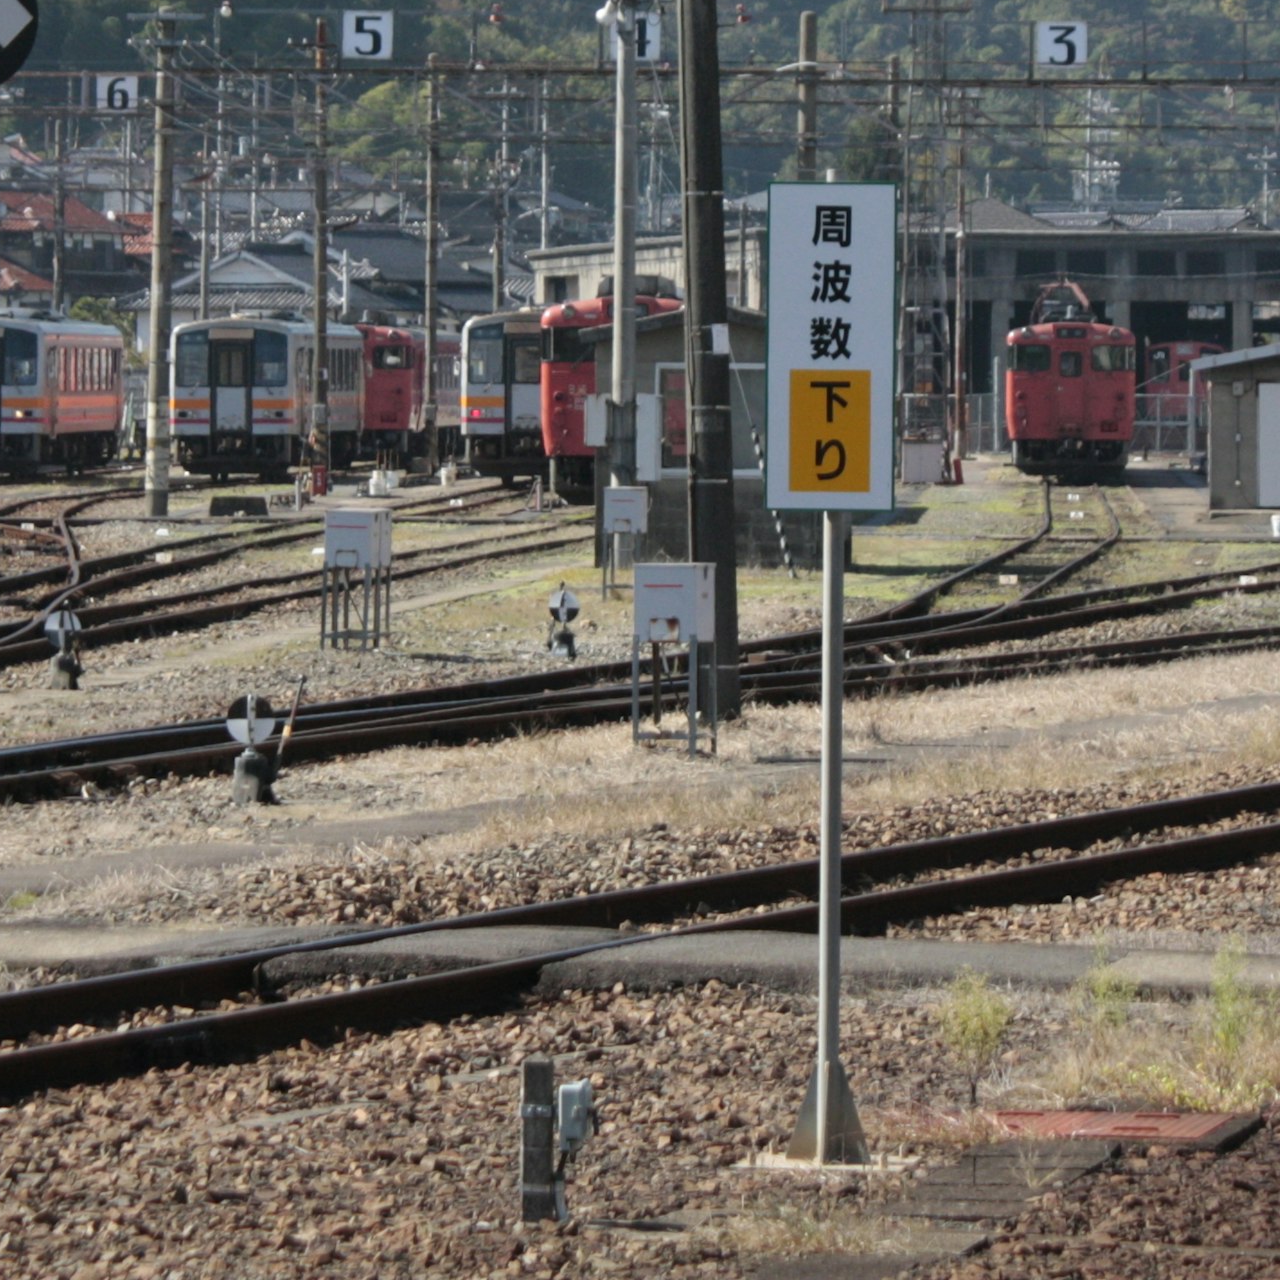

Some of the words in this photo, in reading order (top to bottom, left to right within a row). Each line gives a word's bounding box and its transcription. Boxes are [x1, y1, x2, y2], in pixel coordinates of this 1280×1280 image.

[354, 13, 382, 55] 5
[1048, 24, 1077, 66] 3
[106, 76, 130, 111] 6
[809, 205, 853, 362] 周波数
[809, 380, 850, 481] 下り
